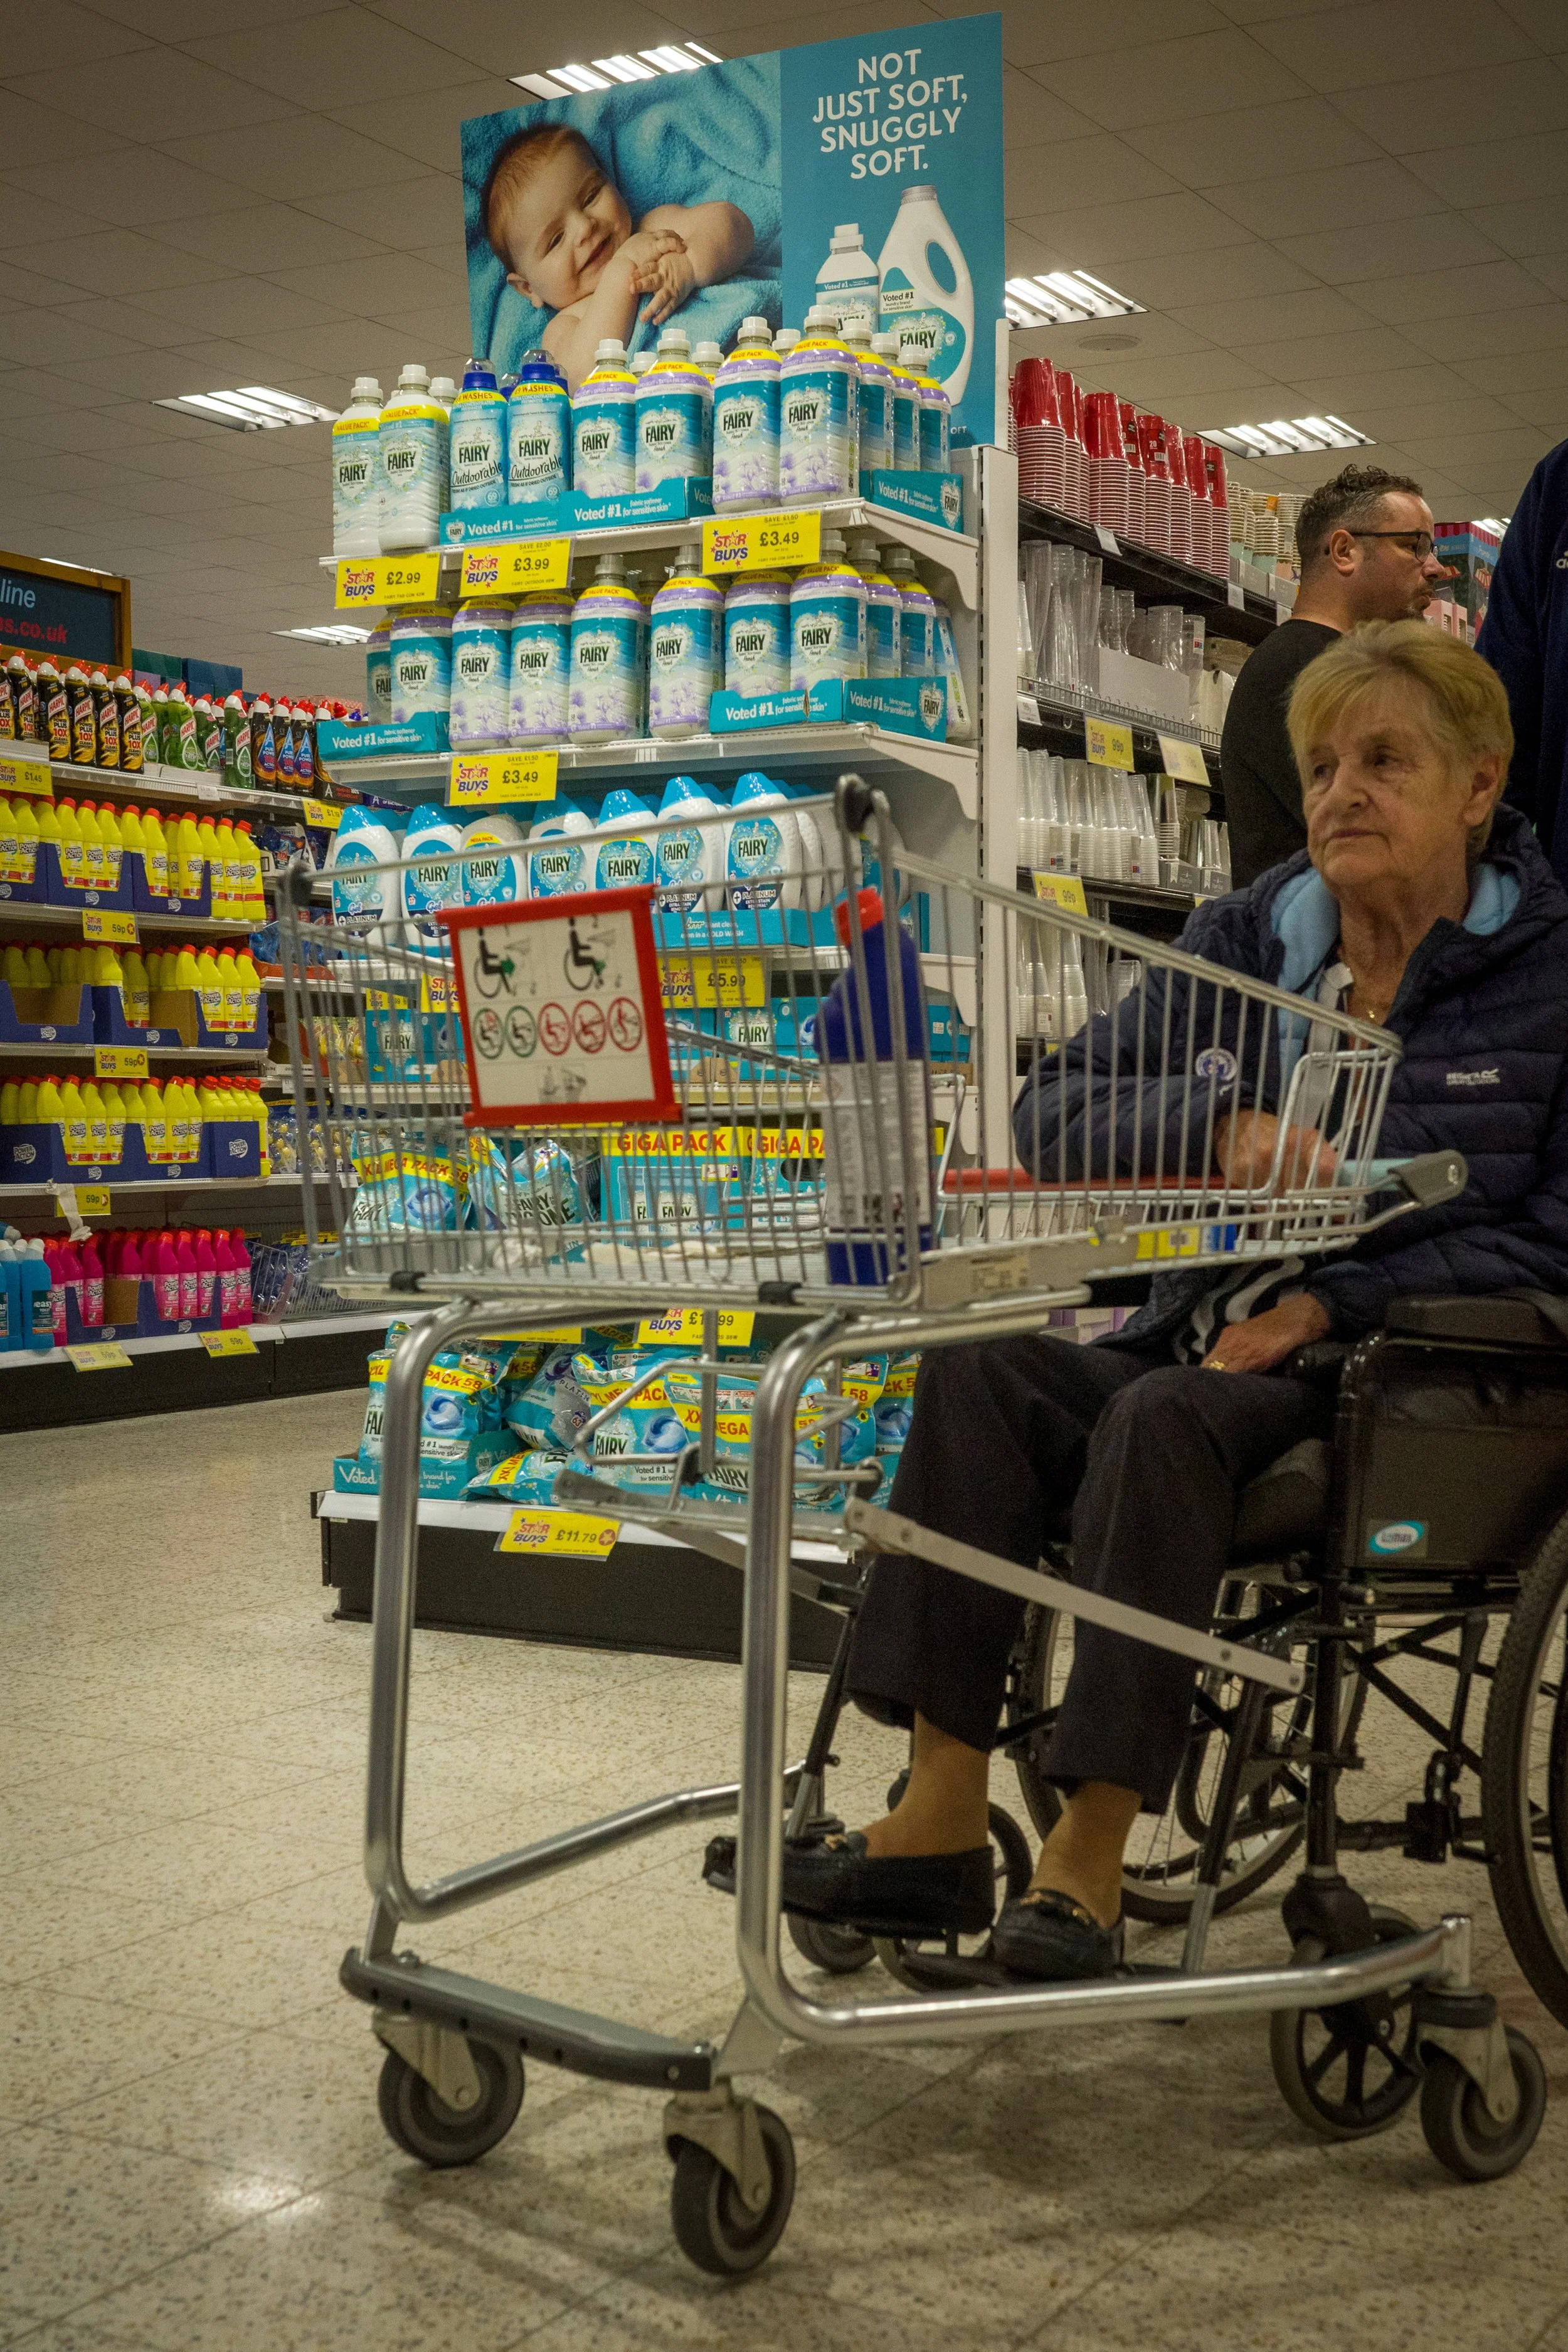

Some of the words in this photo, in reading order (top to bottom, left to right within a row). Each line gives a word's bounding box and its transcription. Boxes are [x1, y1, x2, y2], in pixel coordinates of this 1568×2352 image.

[858, 48, 921, 83] NOT
[813, 88, 880, 123] JUST
[888, 74, 967, 110] SOFT,
[820, 107, 961, 152] SNUGGLY
[850, 144, 928, 179] SOFT.
[824, 282, 841, 290] Voted
[883, 292, 903, 302] Voted
[900, 330, 936, 351] FAIRY
[463, 392, 494, 400] WASHES
[522, 384, 554, 393] WASHES
[723, 410, 753, 431] FAIRY
[788, 402, 818, 423] FAIRY
[336, 423, 352, 432] VALUE
[645, 424, 676, 443] FAIRY
[519, 438, 551, 457] FAIRY
[581, 432, 610, 452] FAIRY
[387, 451, 417, 470] FAIRY
[458, 444, 490, 464] FAIRY
[339, 464, 368, 483] FAIRY
[452, 460, 502, 485] Outdoorable
[511, 454, 563, 479] Outdoorable
[879, 481, 898, 499] Voted
[575, 504, 605, 521] Voted
[607, 504, 621, 517] #1
[630, 505, 657, 516] sensitive
[944, 497, 958, 512] FAIRY
[468, 520, 501, 536] Voted
[502, 520, 514, 531] #1
[524, 521, 546, 529] sensitive
[760, 531, 800, 547] £3.49
[714, 548, 748, 562] BUYS
[514, 557, 549, 571] £3.99
[386, 571, 421, 585] £2.99
[467, 571, 498, 583] BUYS
[346, 585, 375, 596] BUYS
[736, 634, 765, 653] FAIRY
[802, 627, 832, 647] FAIRY
[580, 647, 610, 664] FAIRY
[656, 638, 682, 657] FAIRY
[461, 657, 490, 674] FAIRY
[520, 652, 549, 670] FAIRY
[400, 665, 428, 682] FAIRY
[850, 691, 872, 709] Voted
[873, 696, 883, 709] #1
[924, 698, 940, 716] FAIRY
[75, 699, 92, 719] HARPIC
[101, 704, 115, 721] HARPIC
[125, 708, 139, 726] HARPIC
[726, 705, 757, 721] Voted
[759, 702, 774, 716] #1
[53, 729, 67, 737] 10X
[79, 733, 93, 741] 10X
[105, 736, 117, 745] 10X
[332, 736, 362, 749] Voted
[364, 733, 376, 744] #1
[385, 736, 408, 744] sensitive
[128, 740, 140, 749] 10X
[1092, 743, 1106, 756] BUYS
[1111, 739, 1125, 753] 99p
[24, 772, 42, 783] £1.45
[502, 770, 539, 784] £3.49
[458, 780, 489, 792] BUYS
[327, 809, 340, 818] £1.19
[664, 842, 691, 861] FAIRY
[738, 839, 768, 857] FAIRY
[470, 861, 499, 878] FAIRY
[541, 856, 571, 874] FAIRY
[608, 859, 642, 877] FAIRY
[418, 866, 450, 882] FAIRY
[348, 903, 363, 914] Gel
[426, 901, 442, 913] Gel
[347, 915, 376, 924] PLATINUM
[87, 924, 102, 933] BUYS
[112, 924, 125, 934] 59p
[739, 1026, 768, 1042] FAIRY
[124, 1057, 137, 1067] 59p
[14, 1146, 33, 1155] POWER
[618, 1134, 667, 1151] GIGA
[673, 1134, 726, 1151] PACK
[756, 1136, 801, 1154] GIGA
[14, 1153, 36, 1162] ACTION
[230, 1147, 247, 1155] ACTION
[86, 1194, 100, 1203] 59p
[649, 1320, 683, 1330] BUYS
[427, 1369, 462, 1387] PACK
[463, 1377, 483, 1391] 58
[849, 1388, 868, 1402] 58
[596, 1435, 628, 1456] FAIRY
[339, 1465, 377, 1485] Voted
[423, 1471, 444, 1481] brand
[445, 1471, 457, 1484] for
[514, 1534, 548, 1543] BUYS
[555, 1528, 597, 1544] £11.79
